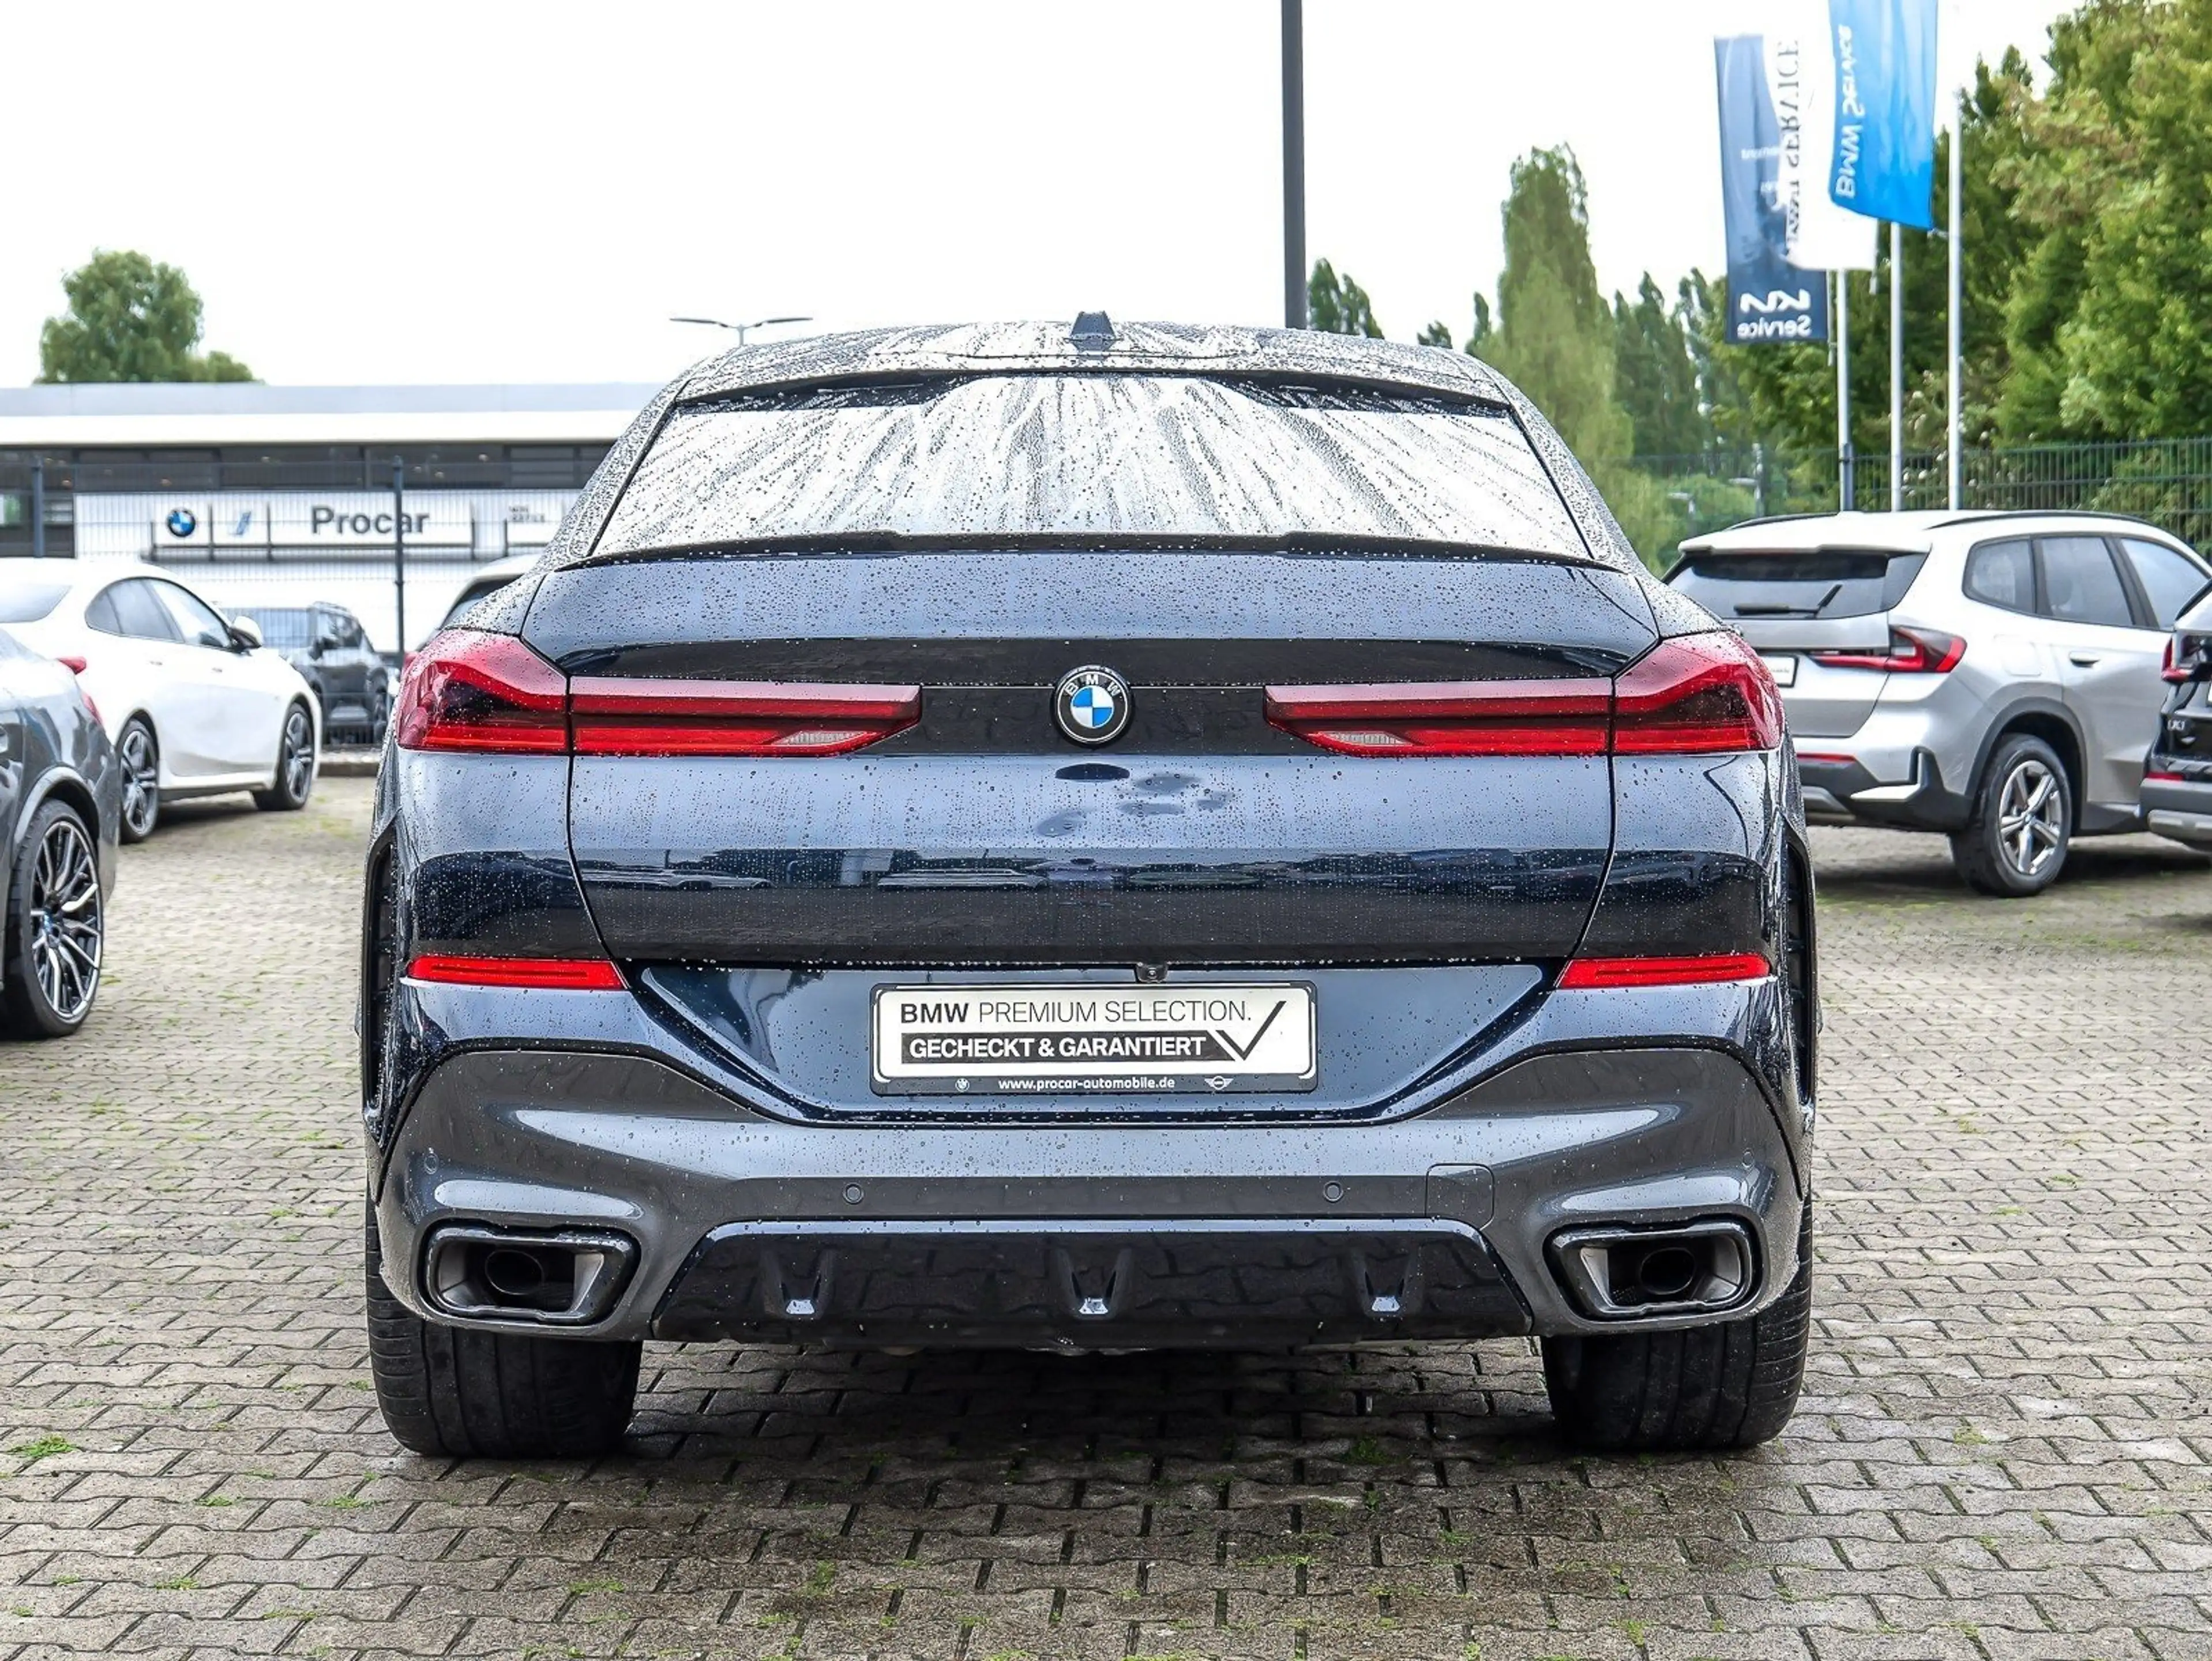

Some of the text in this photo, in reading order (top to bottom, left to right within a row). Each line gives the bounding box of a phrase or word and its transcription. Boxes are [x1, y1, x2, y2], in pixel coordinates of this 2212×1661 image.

[311, 505, 430, 534] Procar
[1064, 674, 1121, 697] BMW
[900, 1000, 1251, 1023] BMW PREMIUM SELECTION.
[908, 1036, 1207, 1059] GECHECKT & GARANTIERT
[998, 1076, 1176, 1092] www.procar-automobile.de
